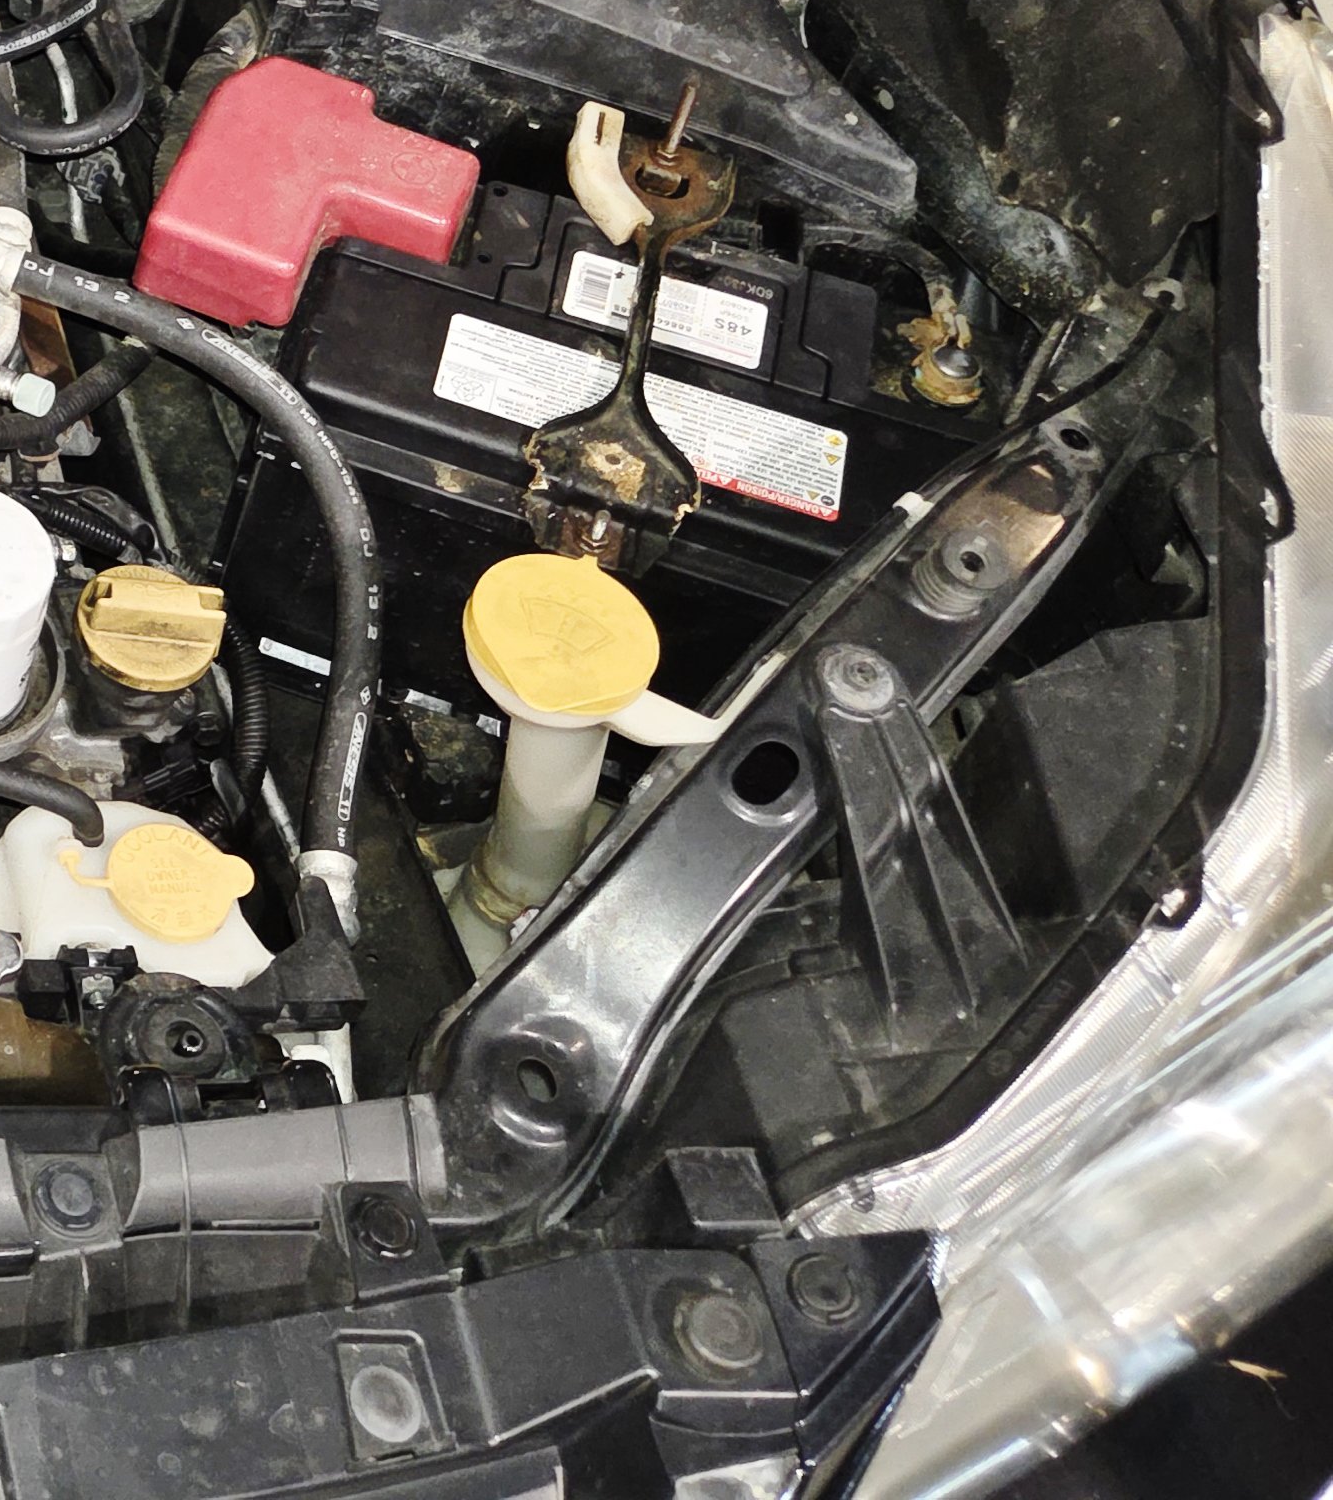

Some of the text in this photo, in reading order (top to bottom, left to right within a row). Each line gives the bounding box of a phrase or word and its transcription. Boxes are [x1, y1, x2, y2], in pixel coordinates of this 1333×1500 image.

[23, 259, 54, 277] DJ
[74, 276, 100, 292] 13
[711, 316, 753, 337] 48S
[735, 480, 821, 514] DANGER/POISON
[116, 827, 213, 862] COOLANT
